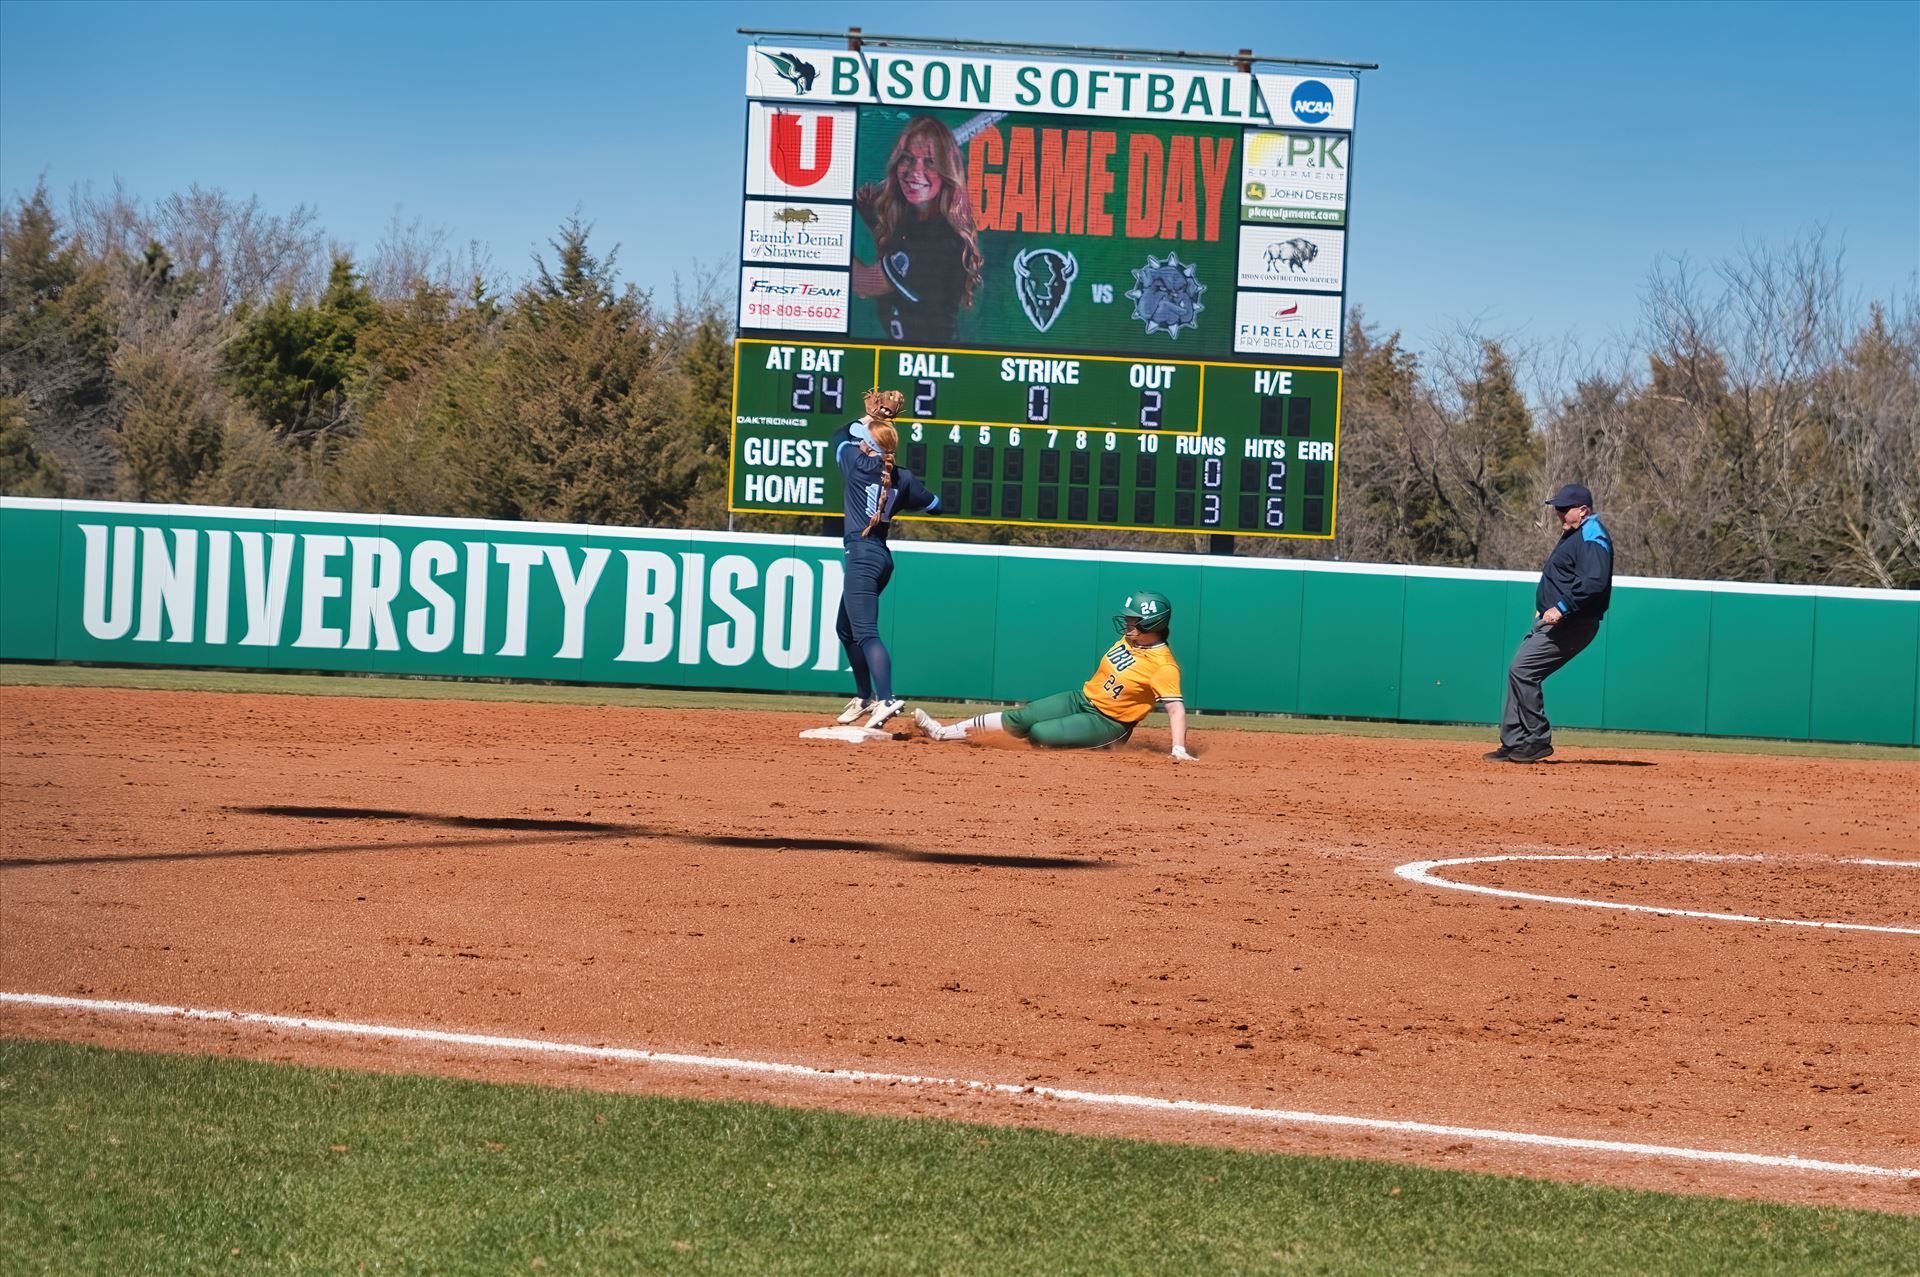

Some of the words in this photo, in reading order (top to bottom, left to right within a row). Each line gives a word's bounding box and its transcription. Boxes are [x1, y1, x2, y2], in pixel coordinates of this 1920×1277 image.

[831, 56, 992, 103] BISON
[1015, 67, 1271, 119] SOFTBALL
[1294, 99, 1332, 114] NCAA
[967, 124, 1117, 236] GAME
[1125, 133, 1234, 241] DAY
[1270, 187, 1303, 200] JOHN
[1248, 207, 1339, 220] pkequipment.com
[750, 229, 794, 247] Family
[798, 231, 843, 247] Dental
[751, 244, 762, 257] of
[763, 244, 821, 259] Shawnee
[749, 303, 841, 319] 918-808-6602
[1241, 324, 1334, 340] FIRELAKE
[1263, 337, 1299, 349] BREAD
[1303, 340, 1333, 351] TACO
[766, 347, 796, 370] AT
[801, 348, 844, 373] BAT
[899, 353, 954, 379] BALL
[1000, 357, 1080, 385] STRIKE
[1129, 364, 1176, 389] OUT
[1254, 370, 1292, 396] H/E
[792, 373, 844, 410] 24
[914, 379, 936, 416] 2
[1028, 385, 1049, 422] 0
[736, 416, 809, 427] DAKTRONICS
[1141, 390, 1162, 427] 2
[744, 437, 829, 468] GUEST
[911, 423, 923, 442] 3
[949, 425, 961, 444] 4
[979, 425, 991, 445] 5
[1009, 427, 1021, 447] 6
[1047, 430, 1058, 448] 7
[1076, 431, 1087, 449] 8
[1105, 432, 1116, 450] 9
[1137, 434, 1159, 452] 10
[1176, 436, 1226, 456] RUNS
[1245, 439, 1286, 459] HITS
[1298, 441, 1334, 461] ERR
[1204, 458, 1221, 487] 0
[1268, 461, 1285, 491] 2
[745, 474, 825, 505] HOME
[1204, 495, 1220, 524] 3
[1267, 498, 1284, 527] 6
[77, 523, 612, 660] UNIVERSITY
[1140, 600, 1157, 615] 24
[1103, 674, 1125, 700] 24
